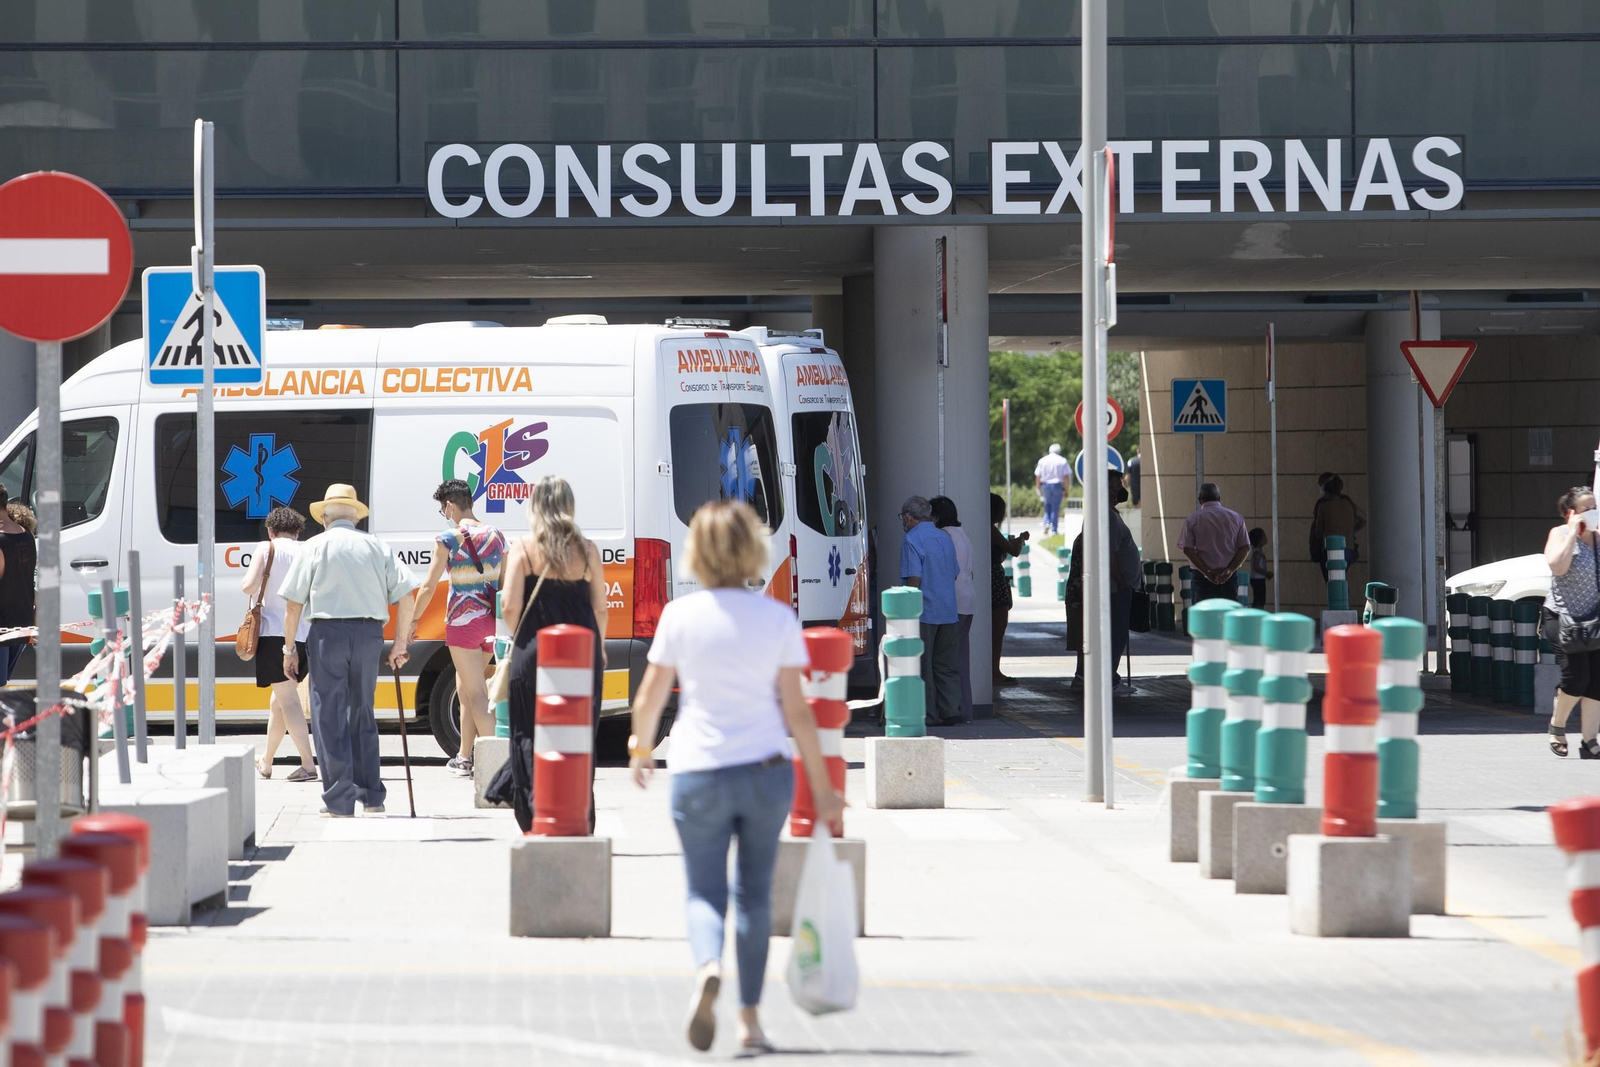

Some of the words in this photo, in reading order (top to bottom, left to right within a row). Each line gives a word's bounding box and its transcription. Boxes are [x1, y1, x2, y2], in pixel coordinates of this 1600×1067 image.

[427, 140, 954, 218] CONSULTAS
[991, 136, 1466, 215] EXTERNAS
[678, 349, 761, 375] AMBULANCIA
[181, 369, 365, 398] LANCIA
[382, 367, 533, 393] COLECTIVA
[711, 383, 718, 391] DE
[442, 417, 549, 498] CTS
[602, 549, 625, 563] DE
